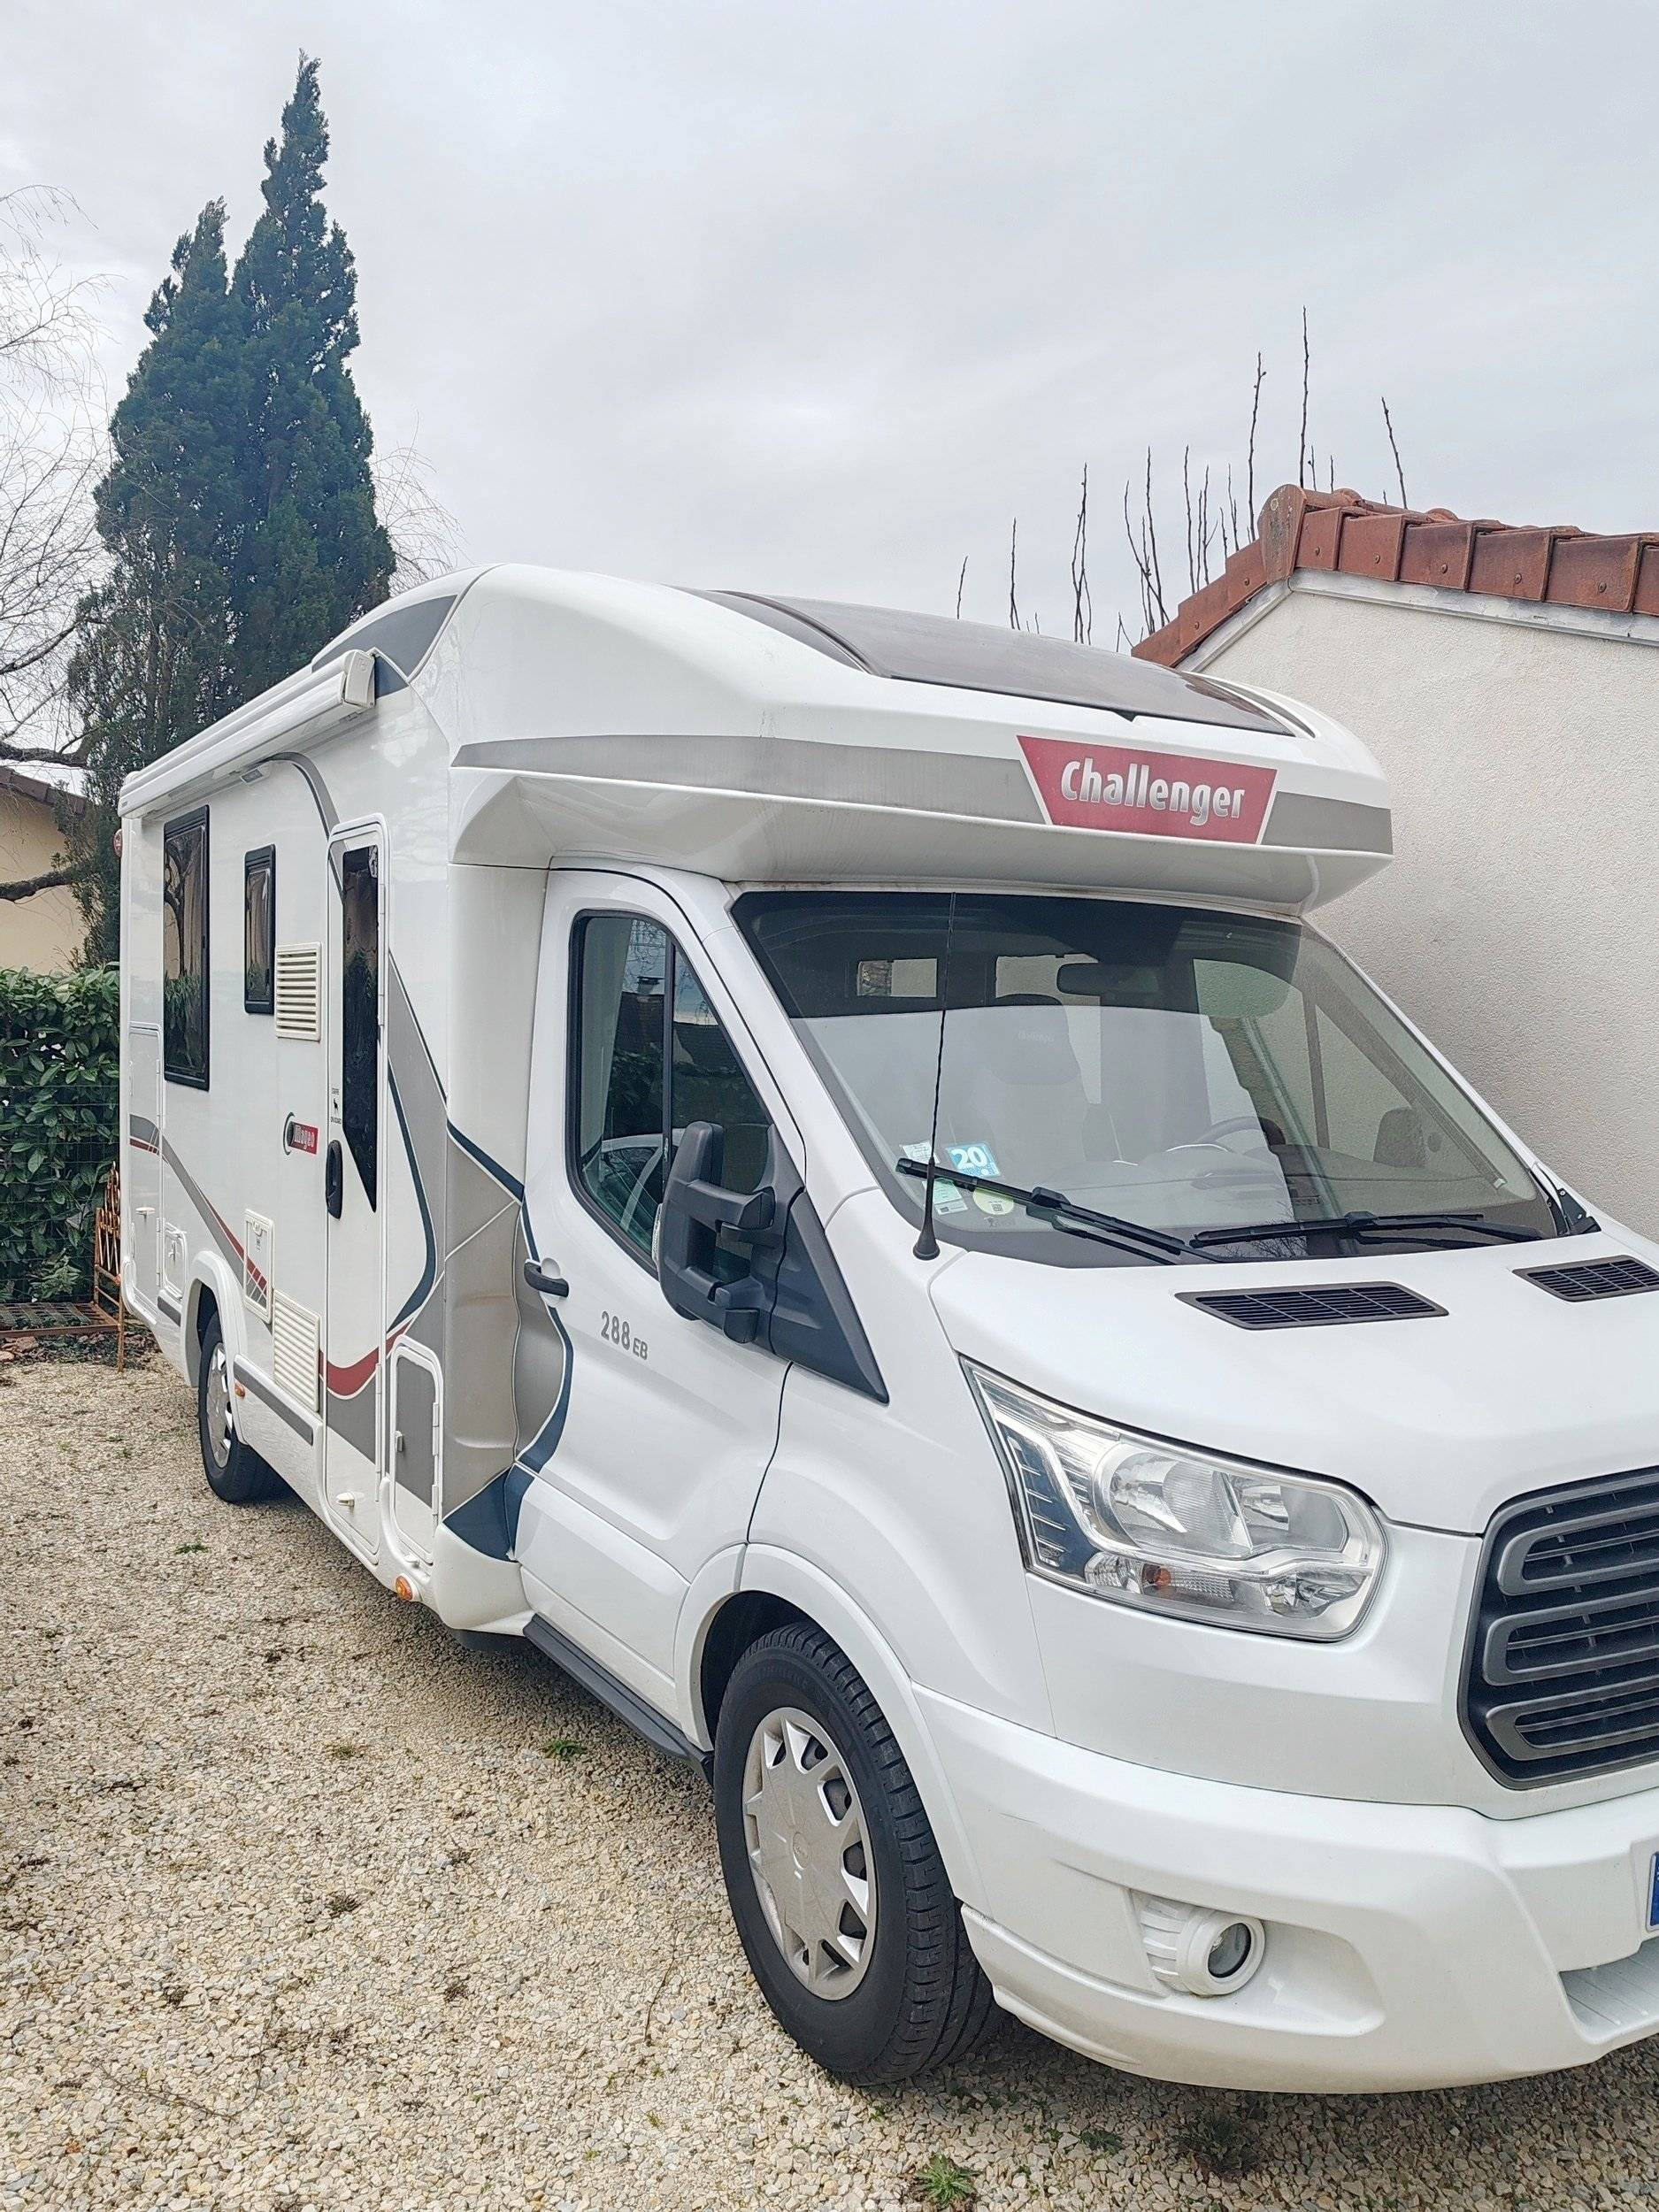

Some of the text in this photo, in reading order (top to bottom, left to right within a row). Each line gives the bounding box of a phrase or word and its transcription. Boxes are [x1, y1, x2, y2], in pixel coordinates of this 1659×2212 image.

[1061, 758, 1245, 826] Challenger
[951, 1147, 987, 1169] 20
[601, 1311, 648, 1360] 288 EB
